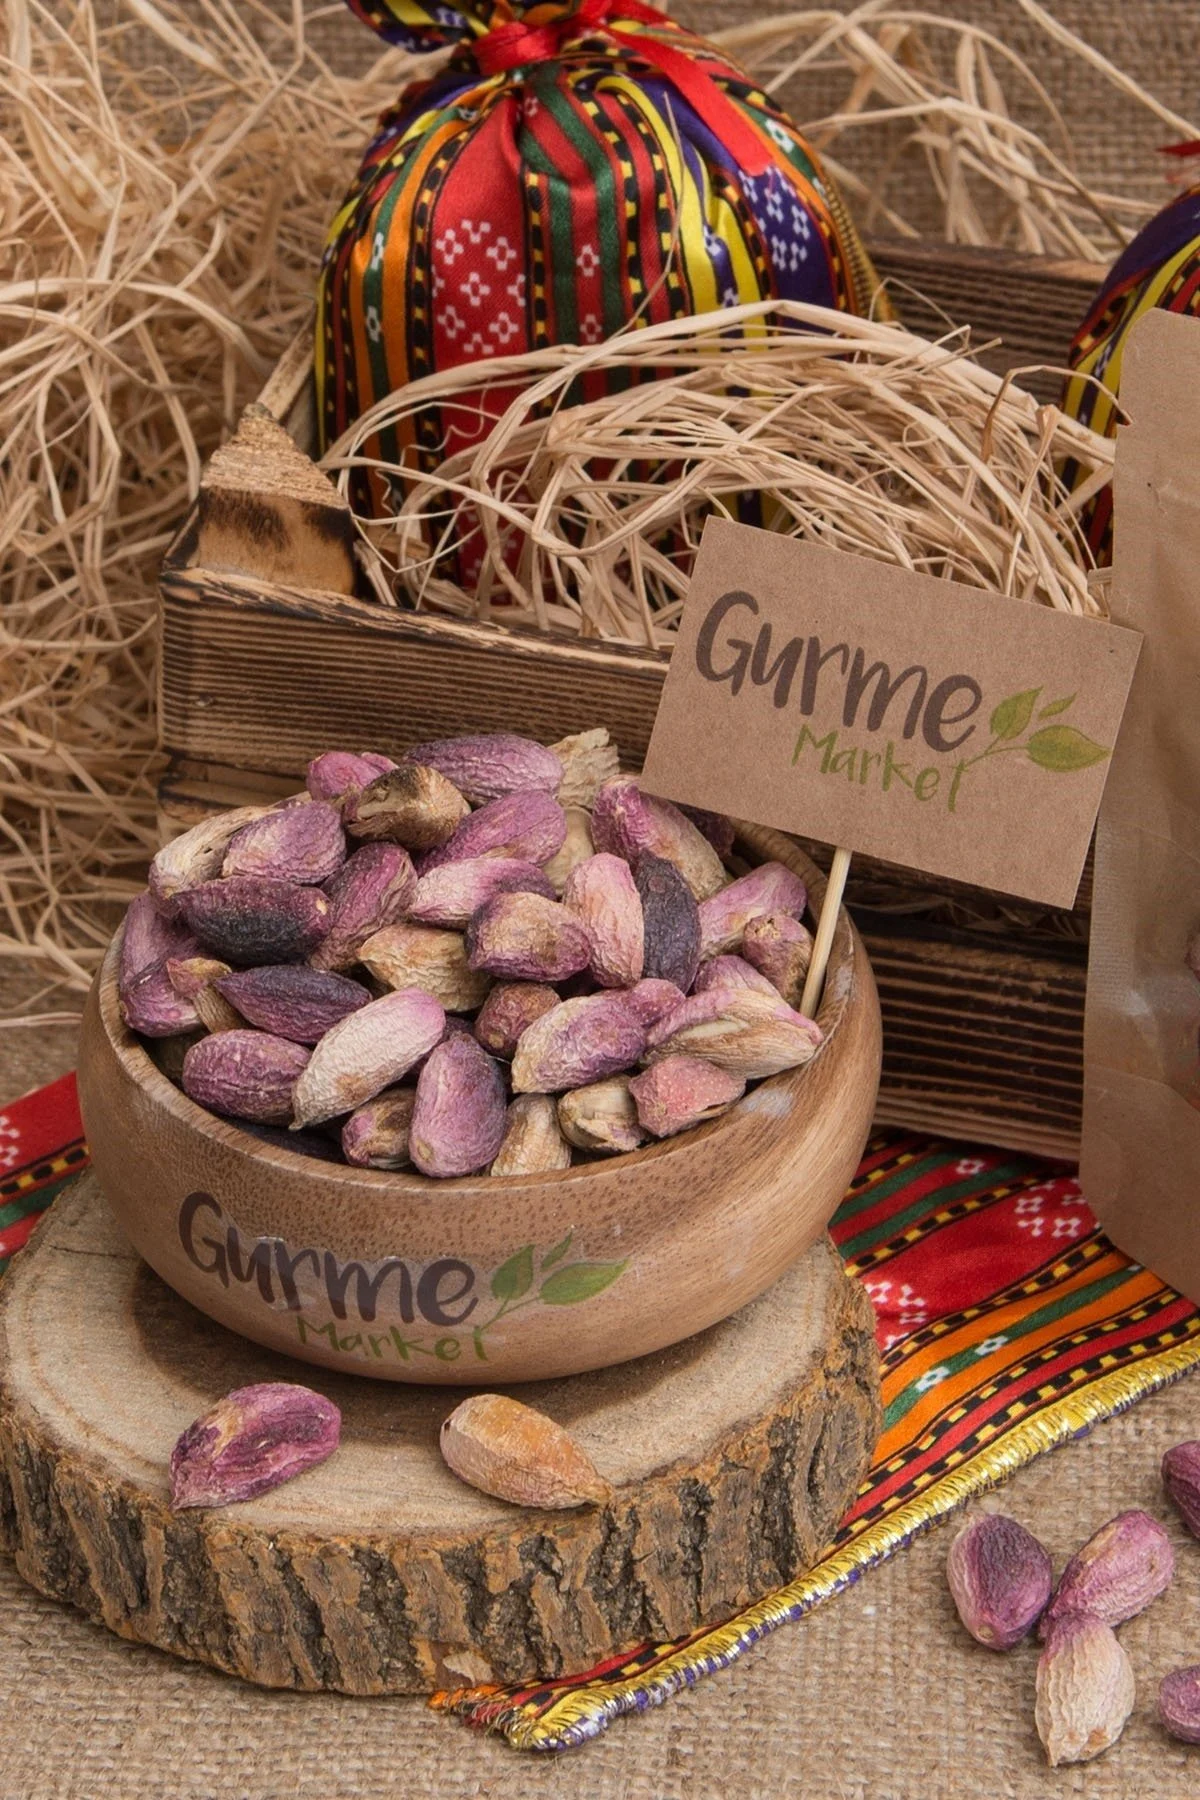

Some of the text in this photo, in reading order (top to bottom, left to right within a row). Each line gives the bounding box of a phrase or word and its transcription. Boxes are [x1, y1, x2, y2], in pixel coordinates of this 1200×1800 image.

[695, 590, 983, 753] Gurme
[791, 724, 969, 812] Market
[178, 1191, 480, 1327] Gurme
[296, 1315, 489, 1362] Market
